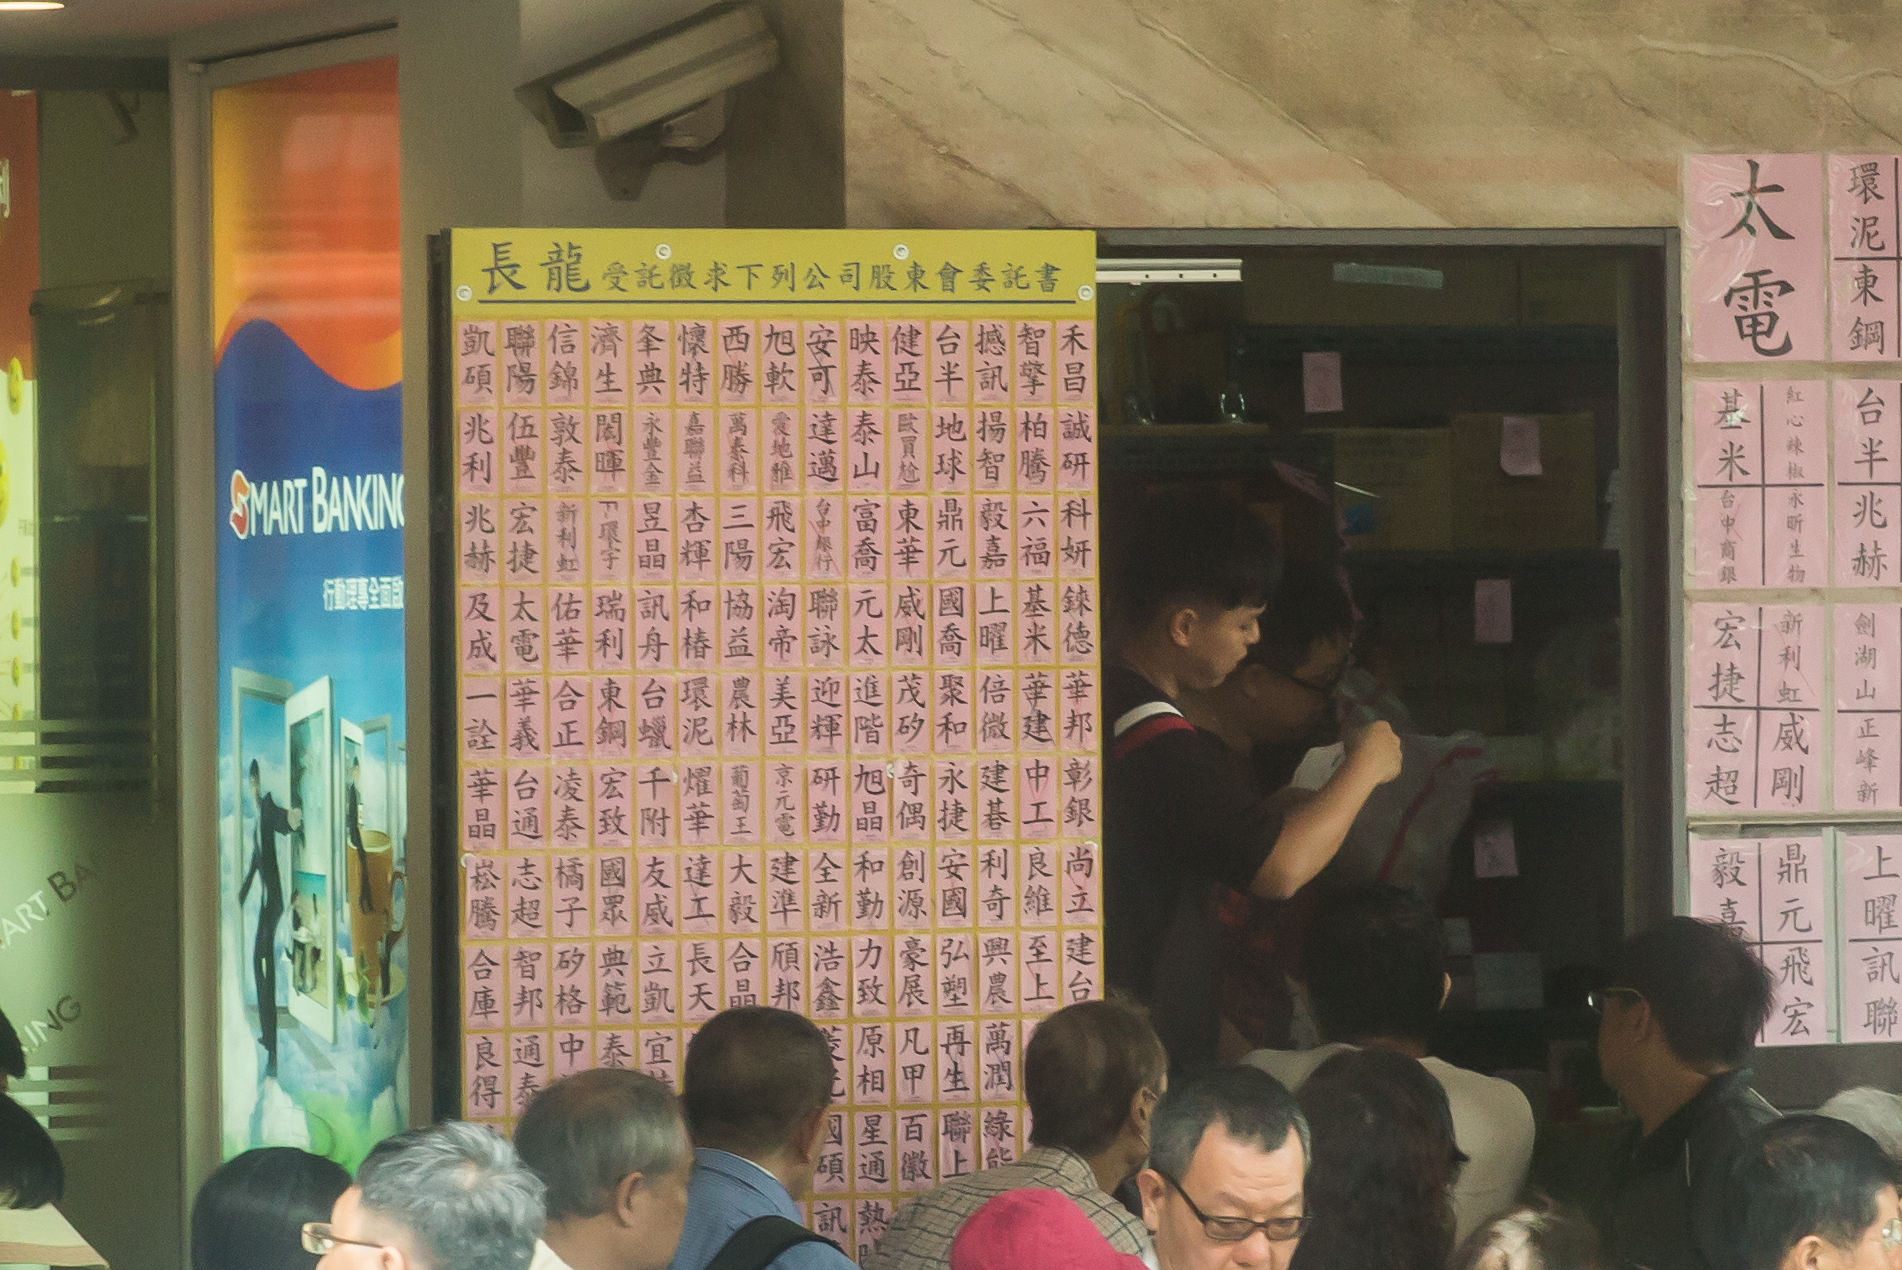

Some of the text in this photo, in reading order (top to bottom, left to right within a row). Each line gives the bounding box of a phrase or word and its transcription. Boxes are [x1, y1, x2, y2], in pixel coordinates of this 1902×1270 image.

[1848, 162, 1886, 252] 環泥
[481, 241, 1061, 294] 長龍 受託徵求下列公司股東會委託書
[1721, 159, 1796, 357] 太電
[461, 324, 496, 394] 凱碩
[548, 323, 578, 396] 信錦
[591, 322, 623, 394] 濟生
[677, 322, 710, 395] 懷特
[764, 324, 796, 395] 旭軟
[850, 323, 882, 397] 映泰
[892, 324, 922, 392] 健亞
[934, 324, 964, 397] 台半
[1060, 324, 1093, 394] 禾昌
[460, 411, 494, 487] 兆利
[550, 412, 582, 484] 敦泰
[807, 411, 839, 486] 達邁
[851, 410, 882, 479] 泰山
[933, 412, 967, 484] 地球
[976, 411, 1007, 485] 揚智
[1015, 411, 1050, 485] 柏騰
[1060, 411, 1092, 482] 誠研
[1854, 387, 1888, 479] 台半
[506, 502, 539, 574] 宏捷
[636, 502, 669, 570] 昱晶
[680, 501, 711, 571] 杏輝
[723, 504, 755, 572] 三陽
[766, 500, 796, 570] 飛宏
[852, 498, 883, 572] 富喬
[894, 499, 924, 573] 東華
[937, 498, 967, 568] 鼎元
[1016, 500, 1051, 571] 六福
[462, 592, 497, 665] 及成
[510, 591, 540, 663] 太電
[594, 590, 626, 660] 瑞利
[637, 590, 670, 663] 訊舟
[680, 589, 712, 659] 和椿
[849, 589, 883, 656] 元太
[934, 585, 967, 657] 國喬
[975, 586, 1010, 655] 上曜
[1708, 610, 1745, 703] 宏捷
[462, 693, 498, 750] 一詮
[505, 678, 540, 752] 華義
[549, 680, 585, 748] 合正
[727, 676, 757, 743] 農林
[769, 675, 798, 745] 美亞
[850, 674, 884, 749] 進階
[893, 673, 926, 748] 茂矽
[934, 674, 968, 748] 聚和
[1064, 758, 1095, 828] 彰銀
[1705, 713, 1742, 805] 志超
[463, 768, 498, 843] 華晶
[506, 769, 543, 842] 台通
[593, 767, 629, 841] 宏致
[638, 766, 671, 838] 千附
[731, 764, 752, 835] 葡萄王
[808, 766, 841, 834] 研勤
[851, 764, 888, 837] 旭晶
[511, 858, 543, 929] 志超
[555, 857, 587, 928] 橘子
[729, 854, 759, 925] 大毅
[809, 852, 843, 922] 全新
[853, 850, 885, 926] 和勤
[894, 850, 927, 925] 創源
[980, 848, 1011, 921] 利奇
[1777, 843, 1812, 933] 鼎元
[1863, 846, 1900, 934] 上曜
[465, 949, 500, 1026] 合庫
[512, 950, 544, 1025] 智邦
[554, 947, 588, 1023] 矽格
[639, 945, 677, 1021] 立凱
[852, 938, 890, 1014] 力致
[895, 936, 929, 1012] 豪展
[935, 938, 970, 1011] 弘塑
[1862, 947, 1900, 1036] 訊聯
[470, 1036, 502, 1109] 良得
[857, 1025, 885, 1095] 原相
[901, 1027, 930, 1095] 凡甲
[940, 1025, 972, 1092] 再生
[984, 1022, 1013, 1091] 萬潤
[858, 1114, 889, 1182] 星通
[942, 1110, 972, 1178] 聯上
